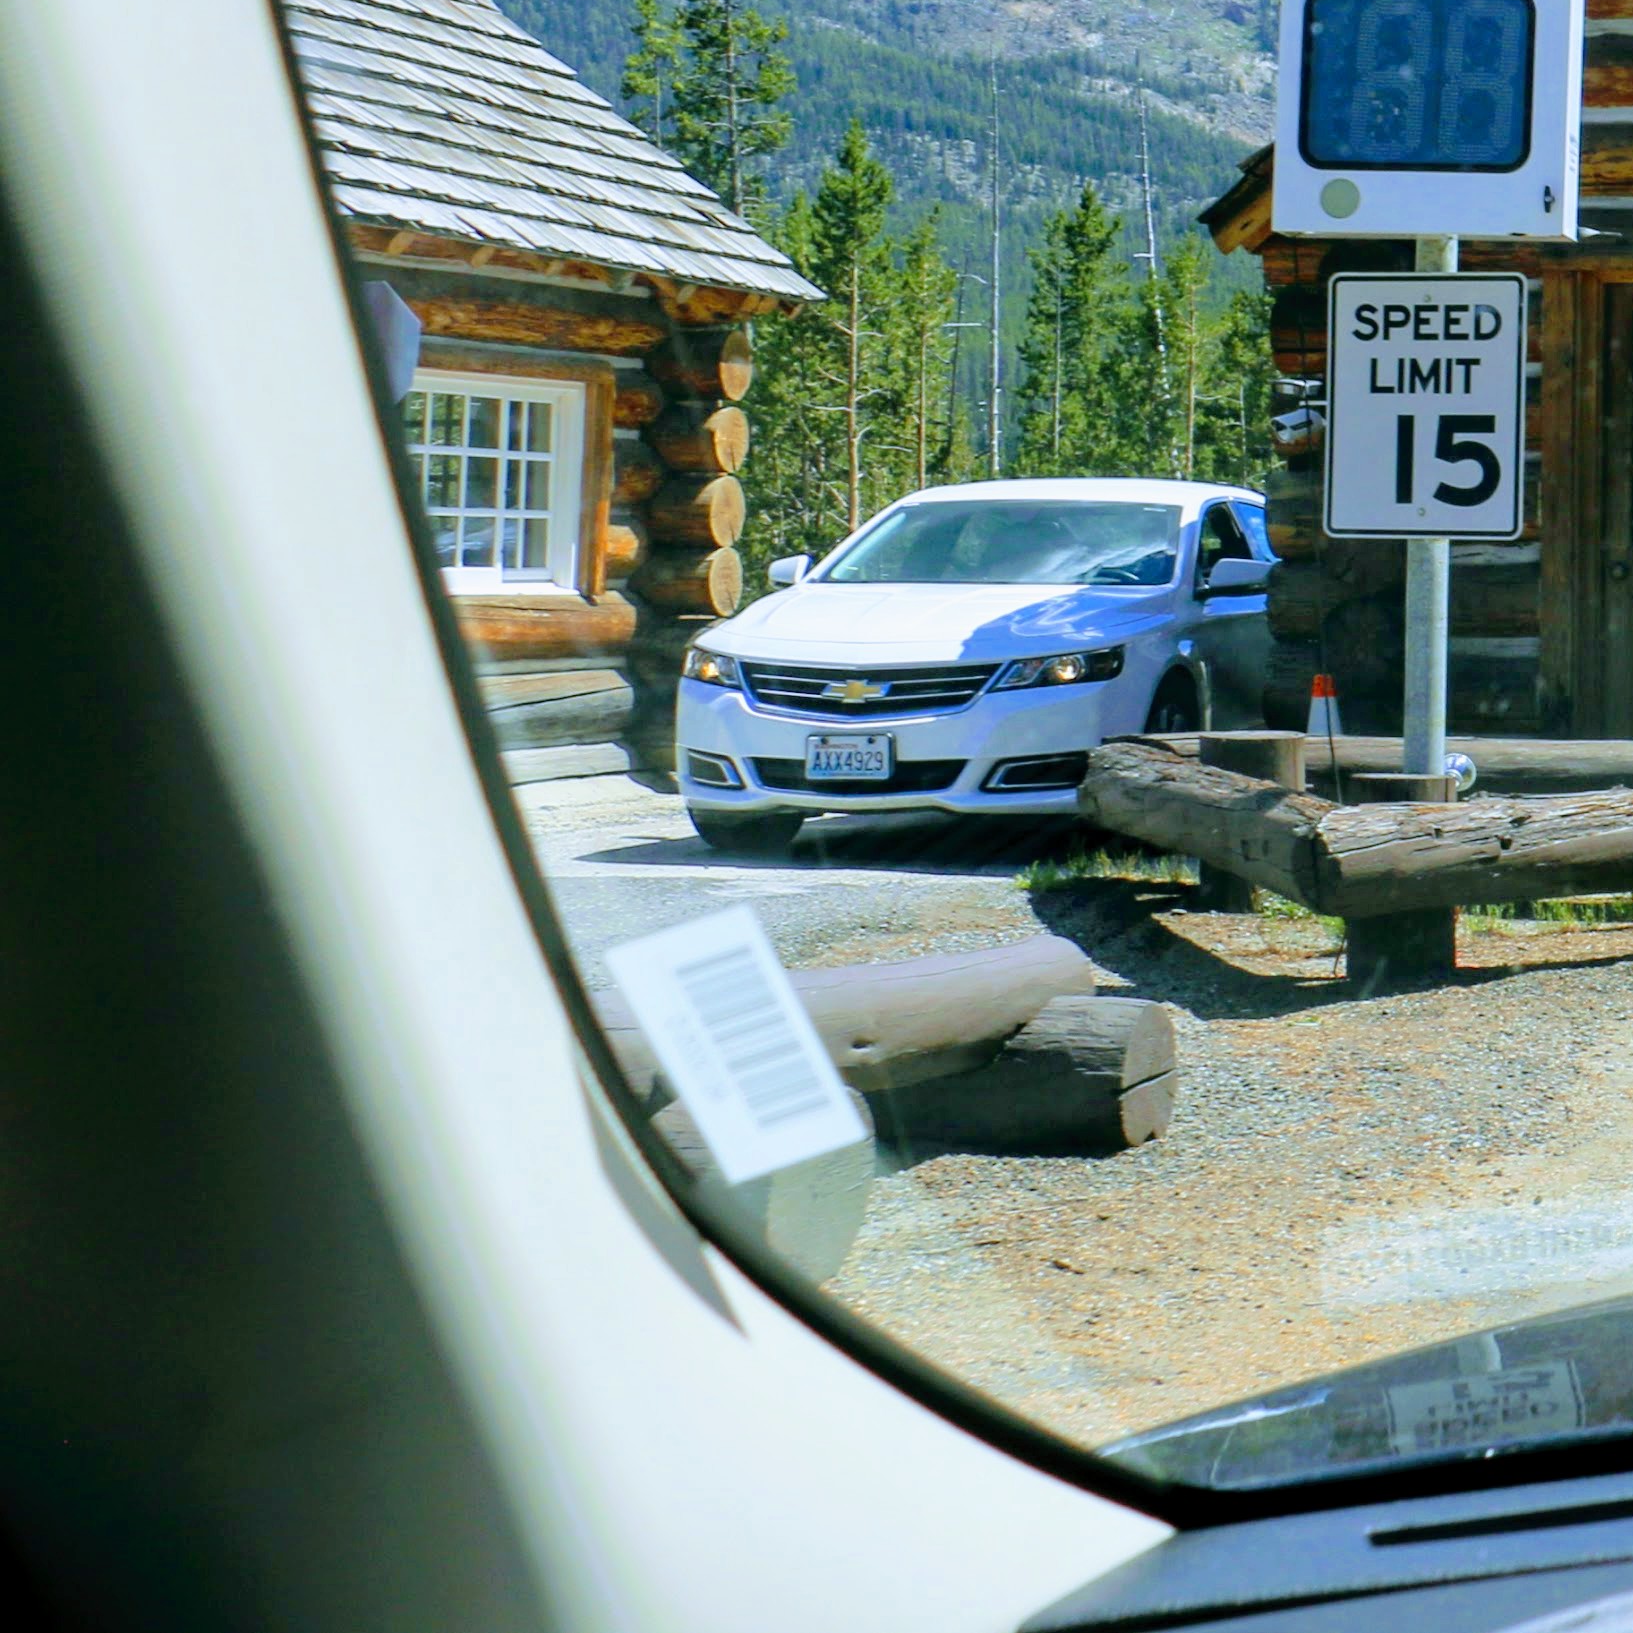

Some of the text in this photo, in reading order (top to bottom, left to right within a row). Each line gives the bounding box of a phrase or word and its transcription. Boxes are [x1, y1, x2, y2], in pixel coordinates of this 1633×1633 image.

[1352, 303, 1502, 342] SPEED
[1369, 357, 1481, 395] LIMIT
[1395, 414, 1501, 507] 15
[812, 751, 884, 771] AXX4929
